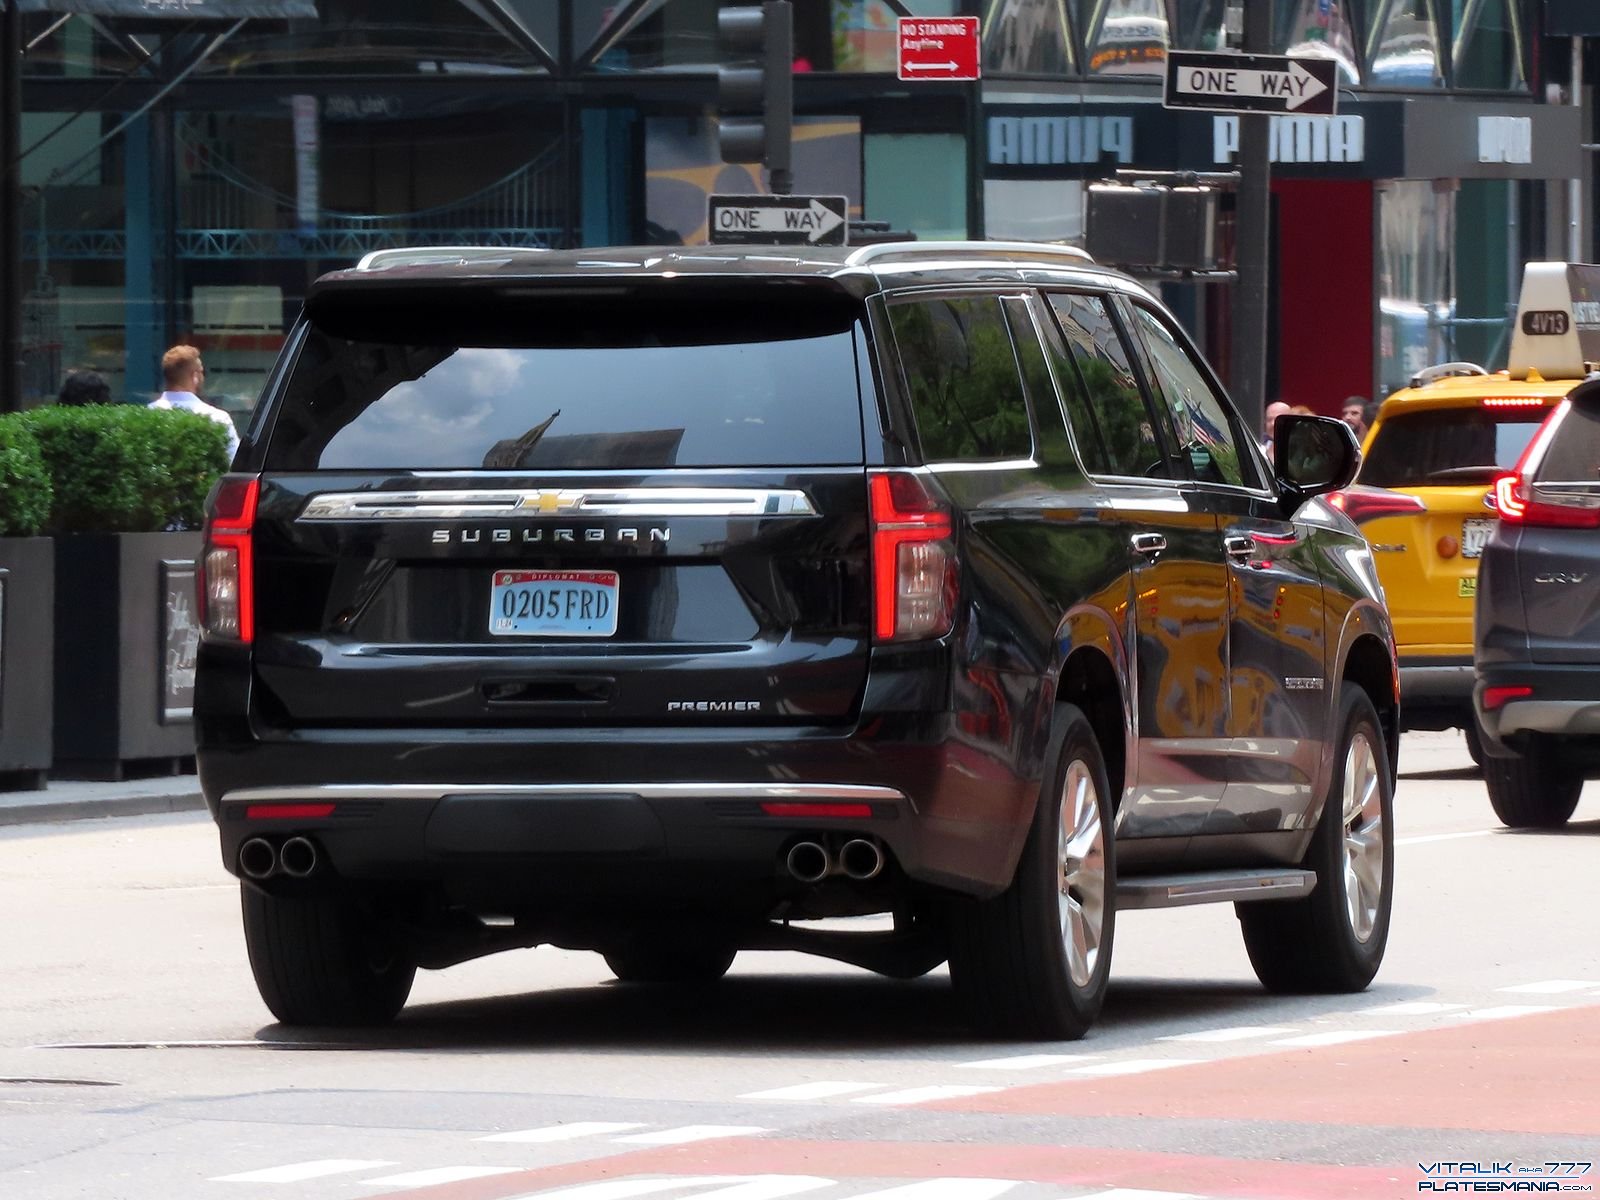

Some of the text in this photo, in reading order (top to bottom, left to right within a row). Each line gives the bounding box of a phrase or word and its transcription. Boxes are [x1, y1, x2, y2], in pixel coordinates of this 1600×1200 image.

[902, 24, 967, 36] NO STANDING
[903, 38, 944, 51] Anytime
[1190, 70, 1310, 97] ONE WAY
[1213, 115, 1365, 163] PMA
[720, 209, 827, 230] ONE WAY
[1531, 313, 1564, 334] 4V13
[432, 528, 671, 543] SUBURBAN
[667, 701, 761, 712] PREMIER
